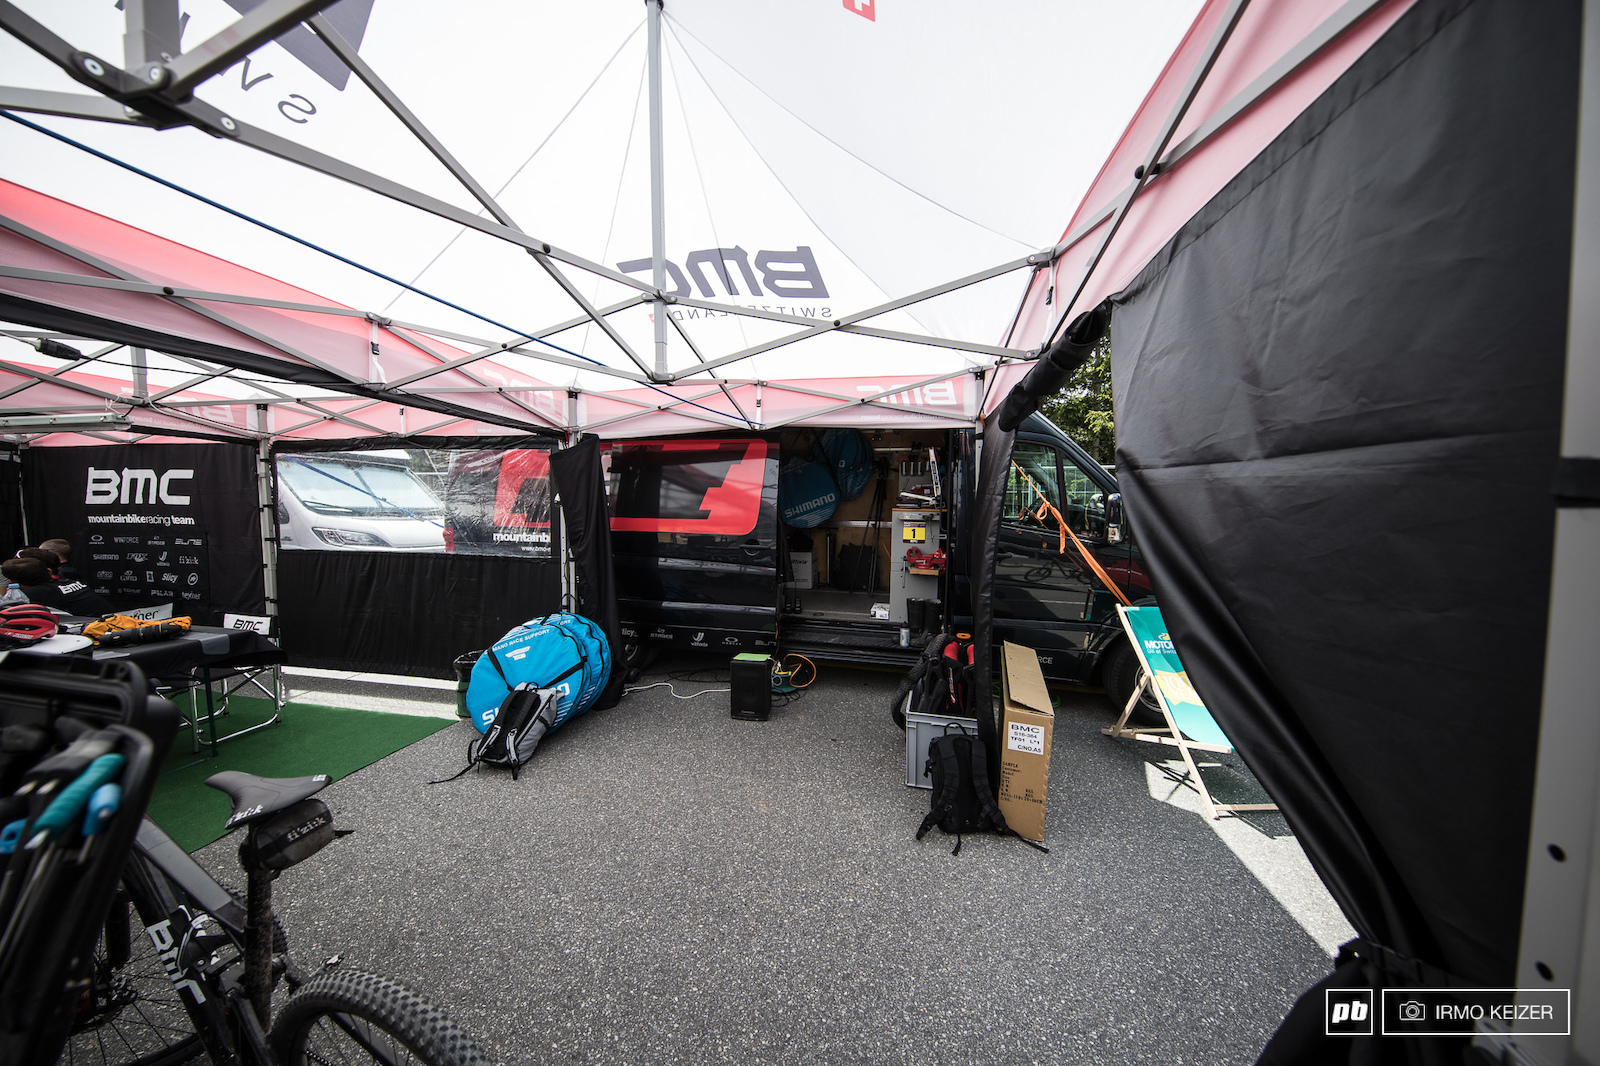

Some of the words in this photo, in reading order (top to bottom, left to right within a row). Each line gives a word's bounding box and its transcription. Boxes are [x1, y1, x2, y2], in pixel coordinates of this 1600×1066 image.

[85, 467, 194, 505] BMC
[784, 493, 836, 518] SHIMANO
[171, 515, 195, 525] team
[493, 532, 551, 542] mountainb
[911, 528, 916, 538] 1
[233, 618, 263, 631] BMC
[524, 629, 550, 641] SUPPORT
[1011, 724, 1040, 733] BMC
